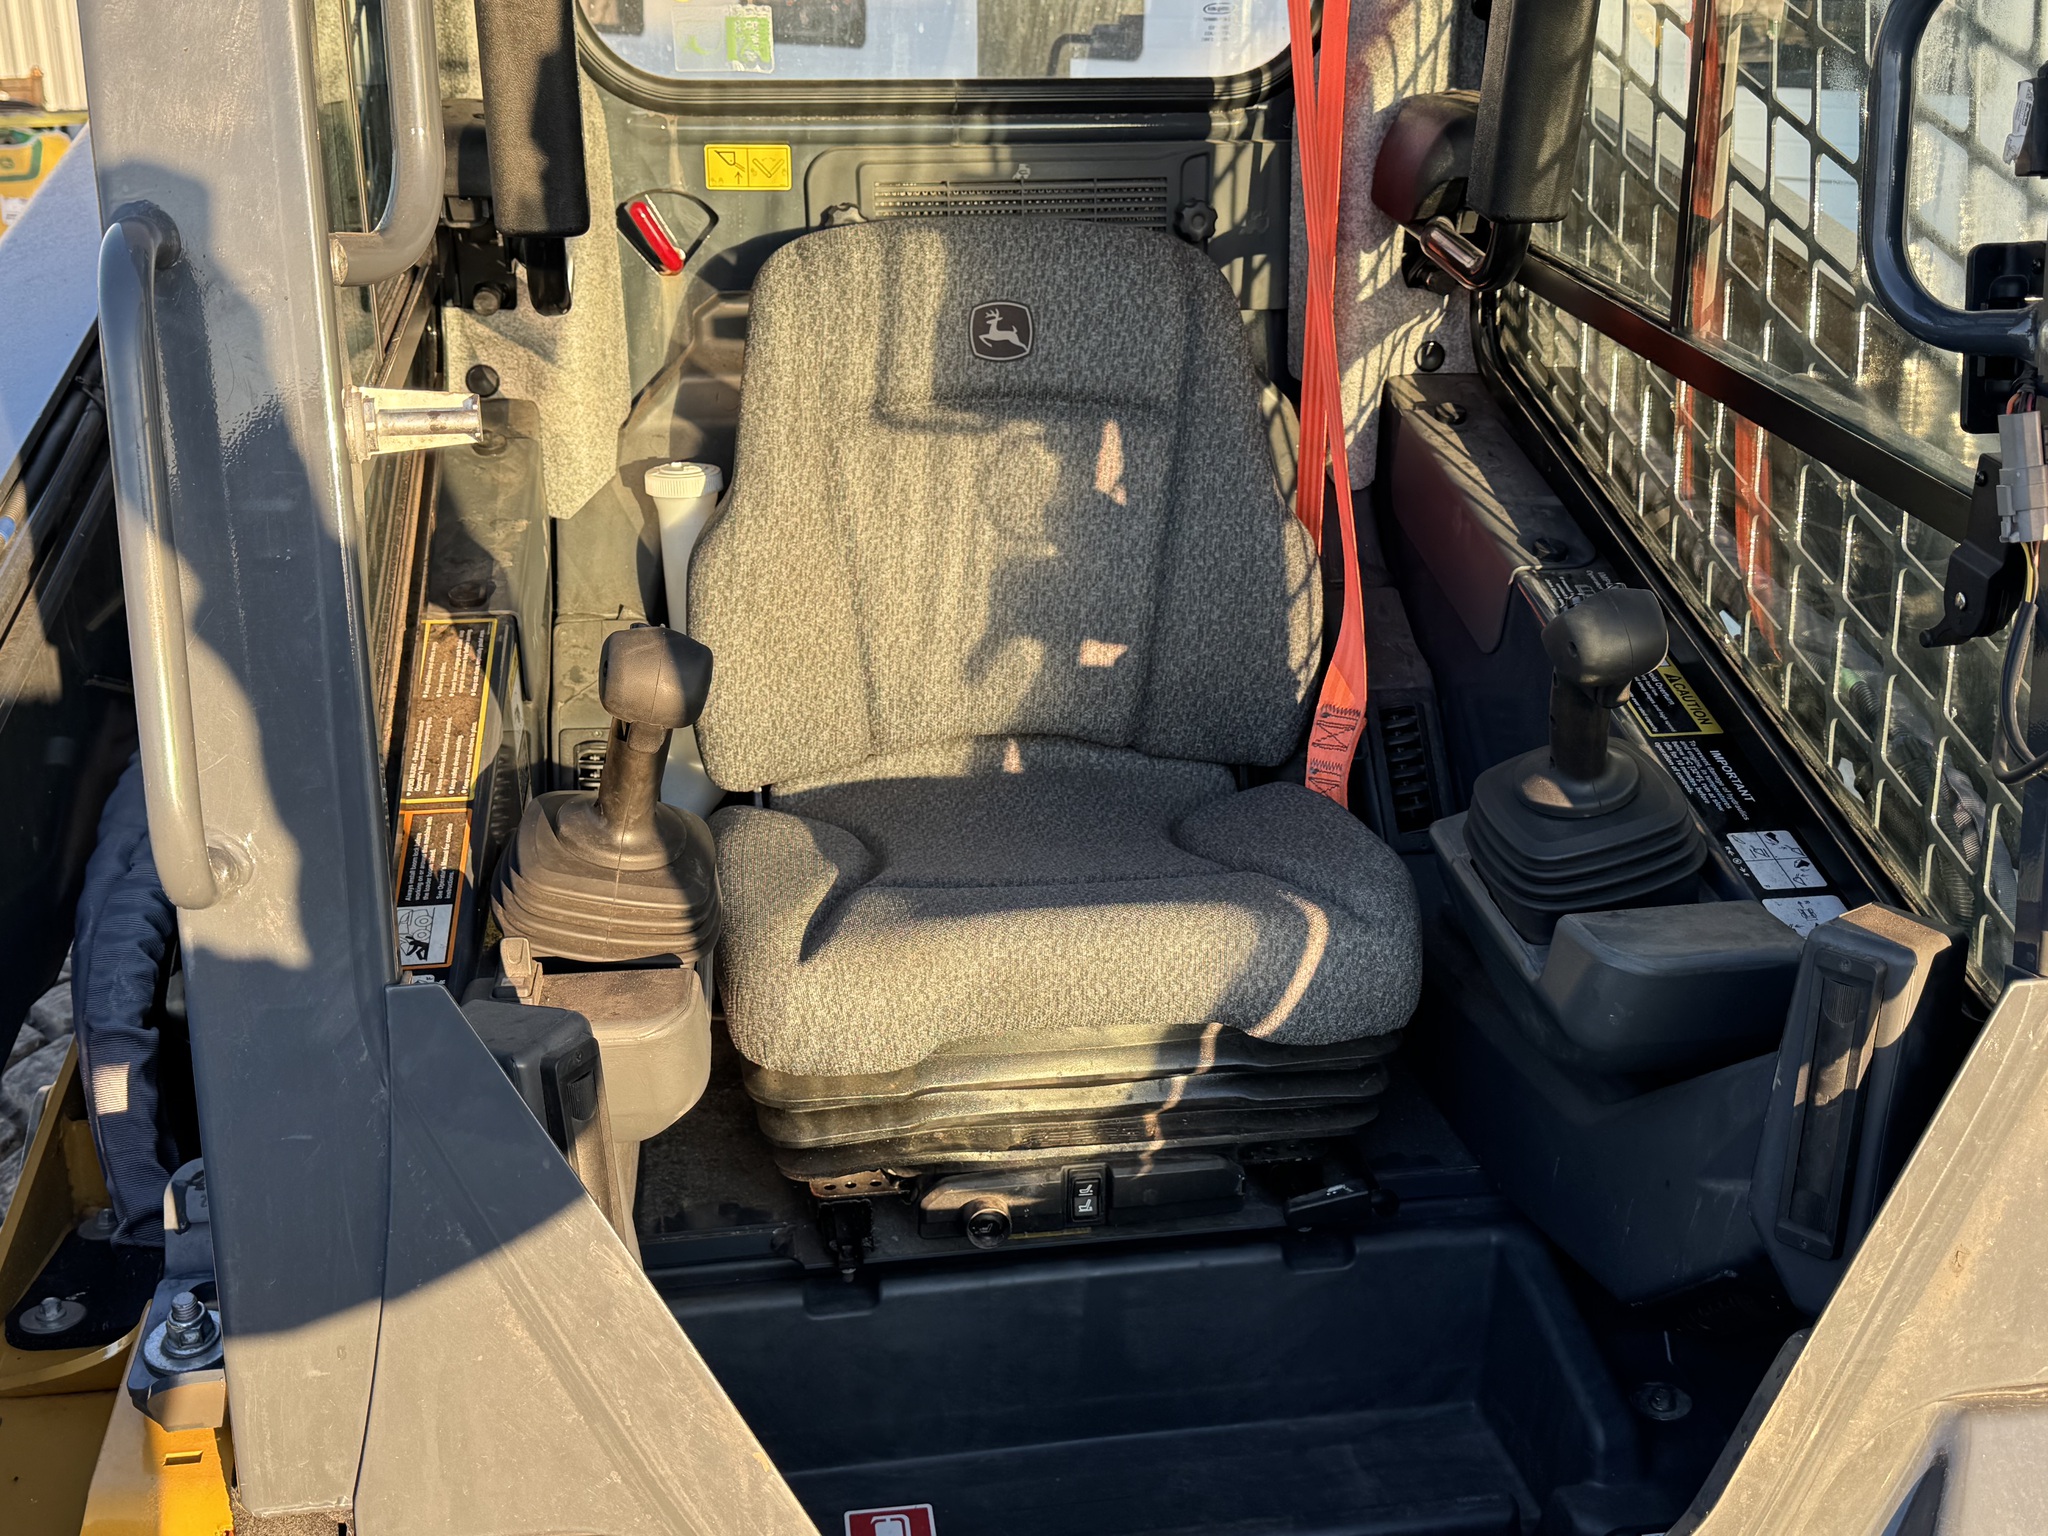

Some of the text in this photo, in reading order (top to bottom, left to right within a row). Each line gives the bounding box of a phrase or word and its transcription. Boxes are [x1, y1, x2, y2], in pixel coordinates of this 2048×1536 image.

[1673, 683, 1713, 725] CAUTION
[1653, 742, 1675, 765] operation
[1671, 741, 1686, 755] below
[1713, 799, 1725, 811] slow
[1680, 741, 1690, 750] and
[1705, 776, 1732, 809] temperatures
[1681, 767, 1698, 786] minutes
[1695, 787, 1711, 804] before
[1693, 748, 1711, 766] prevent
[1707, 767, 1725, 786] damage
[1725, 793, 1750, 821] hydraulics
[1710, 750, 1755, 802] IMPORTANT
[445, 823, 454, 842] complete
[441, 850, 449, 866] Manual
[415, 882, 423, 900] working
[438, 867, 447, 889] Operator's
[445, 871, 454, 898] instructions.
[405, 884, 414, 901] Always
